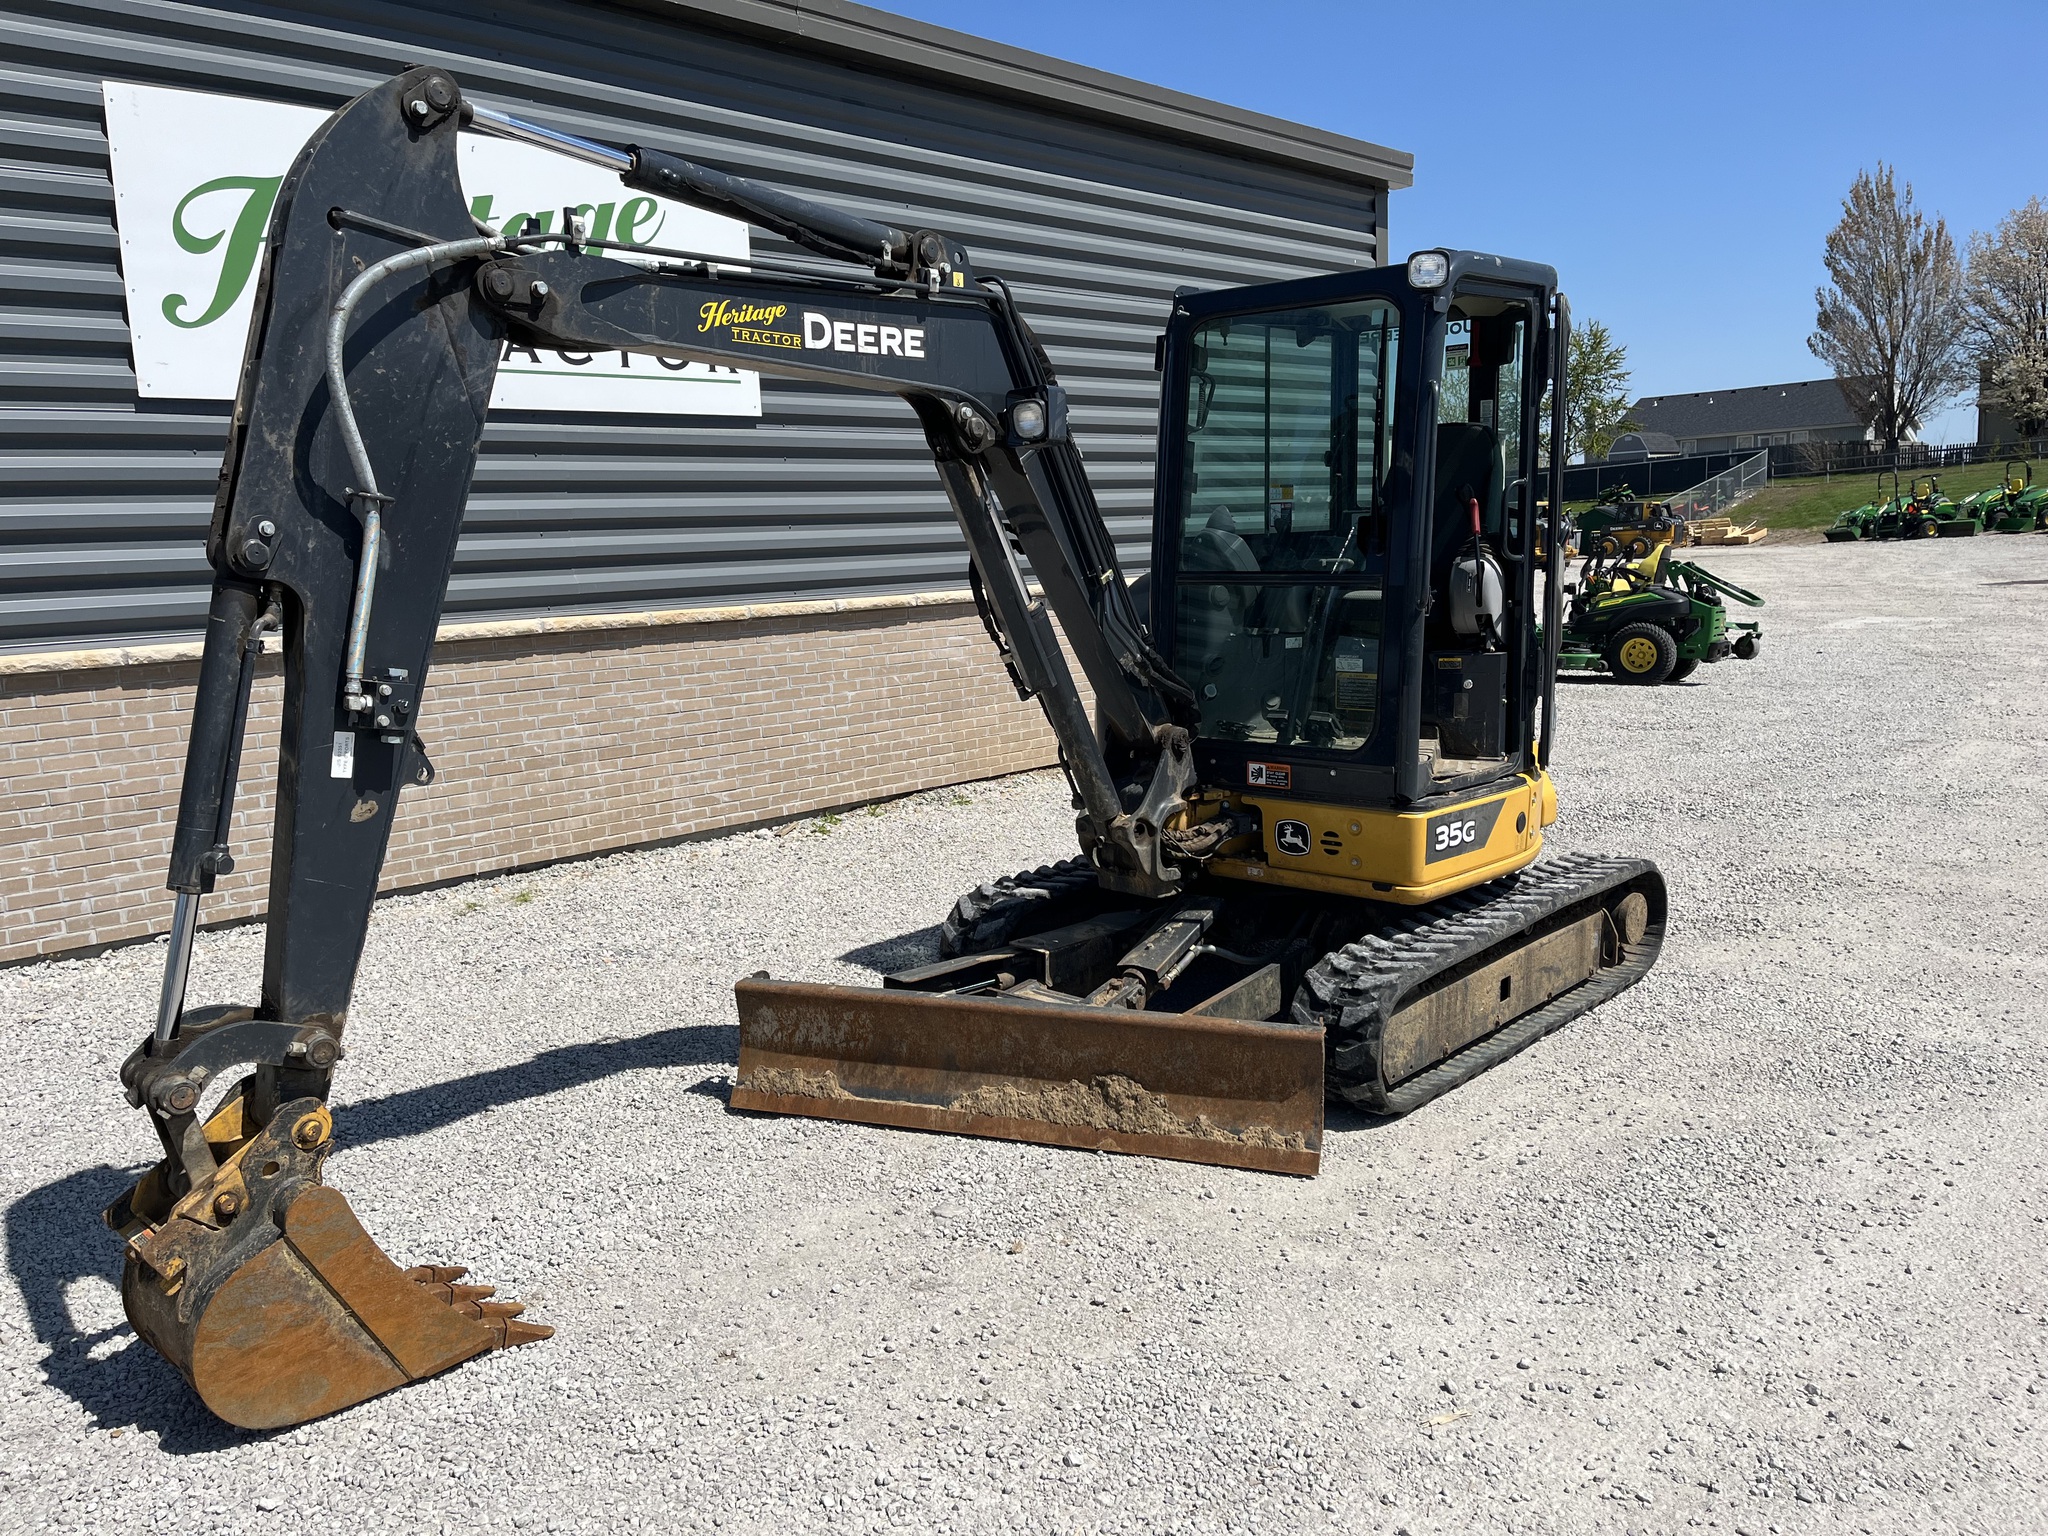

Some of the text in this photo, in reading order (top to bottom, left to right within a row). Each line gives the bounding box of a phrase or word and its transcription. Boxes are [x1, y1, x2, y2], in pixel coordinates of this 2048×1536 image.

[697, 299, 787, 332] Heritage
[731, 329, 802, 347] TRACTOR
[803, 311, 925, 358] DEERE
[1435, 820, 1476, 851] 35G
